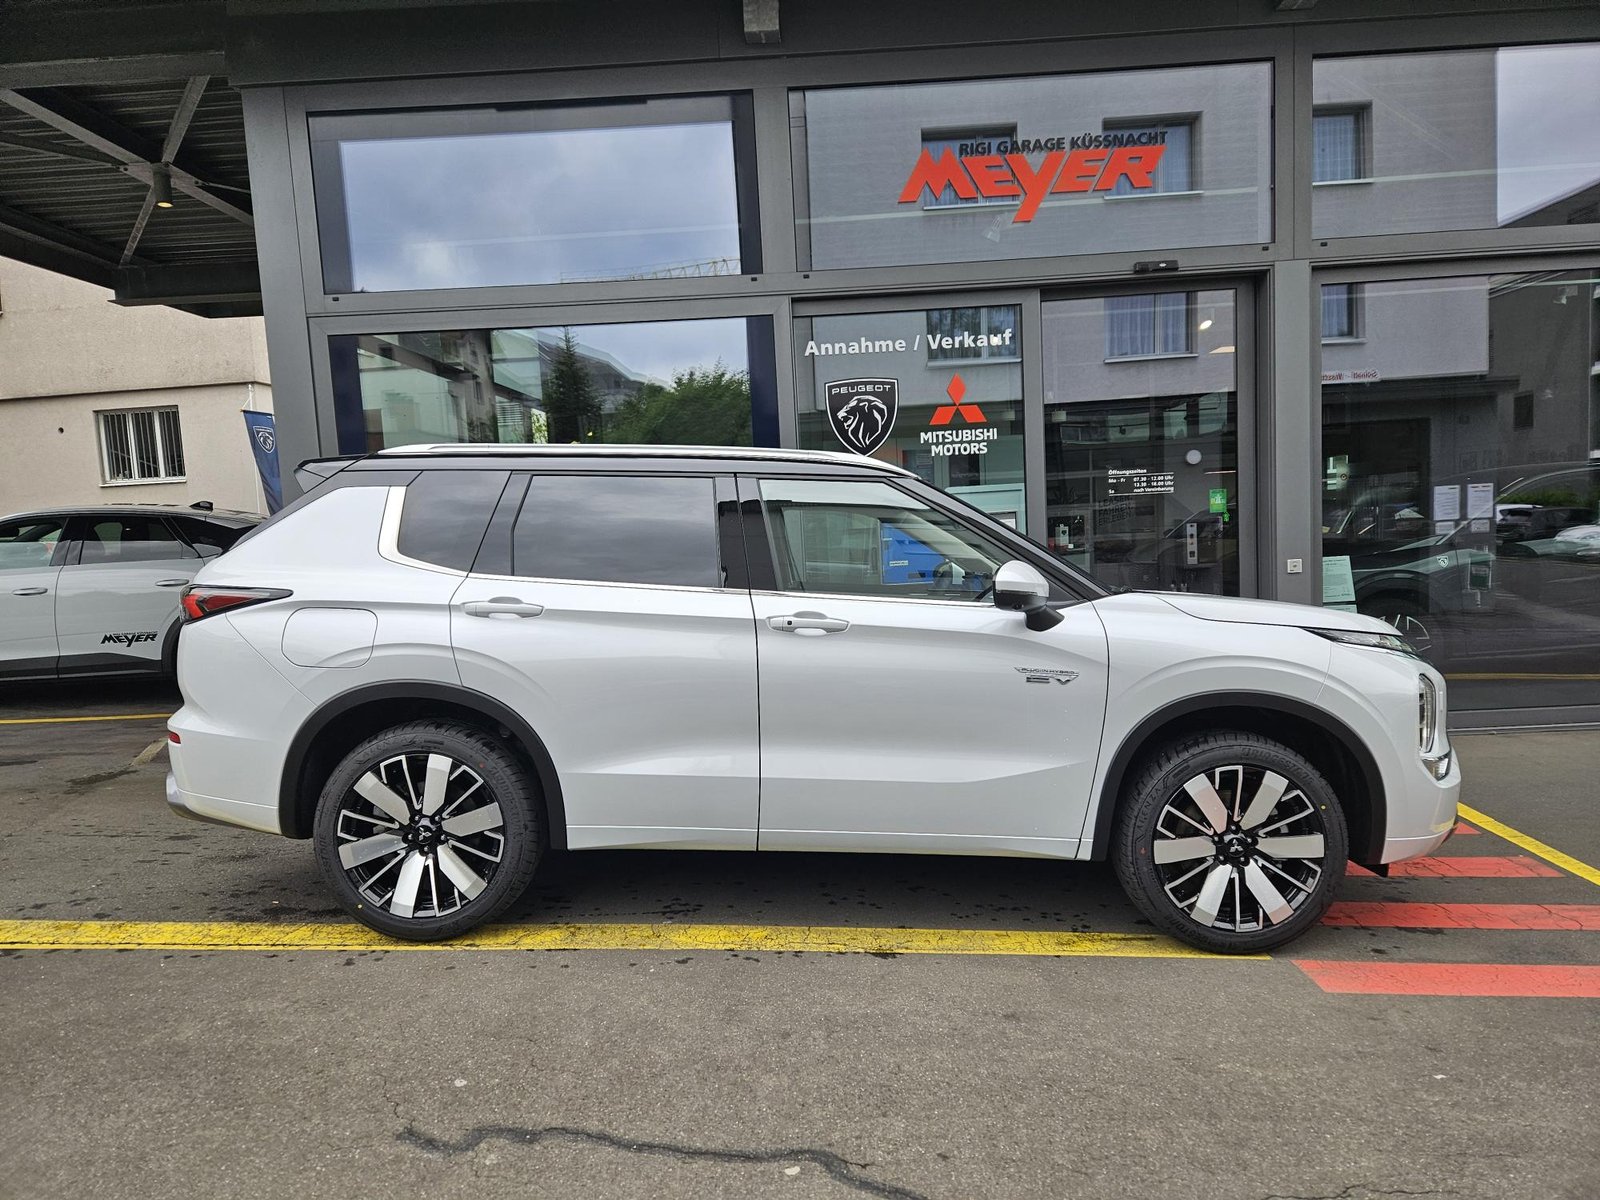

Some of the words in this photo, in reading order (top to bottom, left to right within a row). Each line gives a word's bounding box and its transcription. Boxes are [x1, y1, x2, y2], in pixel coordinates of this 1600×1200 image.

[959, 141, 992, 157] RIGI
[997, 137, 1065, 154] GARAGE
[1070, 130, 1168, 151] KÜSSNACHT
[804, 336, 906, 357] Annahme
[913, 334, 921, 351] /
[927, 328, 1013, 350] Verkauf
[831, 384, 892, 396] PEUGEOT
[920, 427, 998, 444] MITSUBISHI
[931, 442, 988, 457] MOTORS
[100, 633, 158, 647] MEYER
